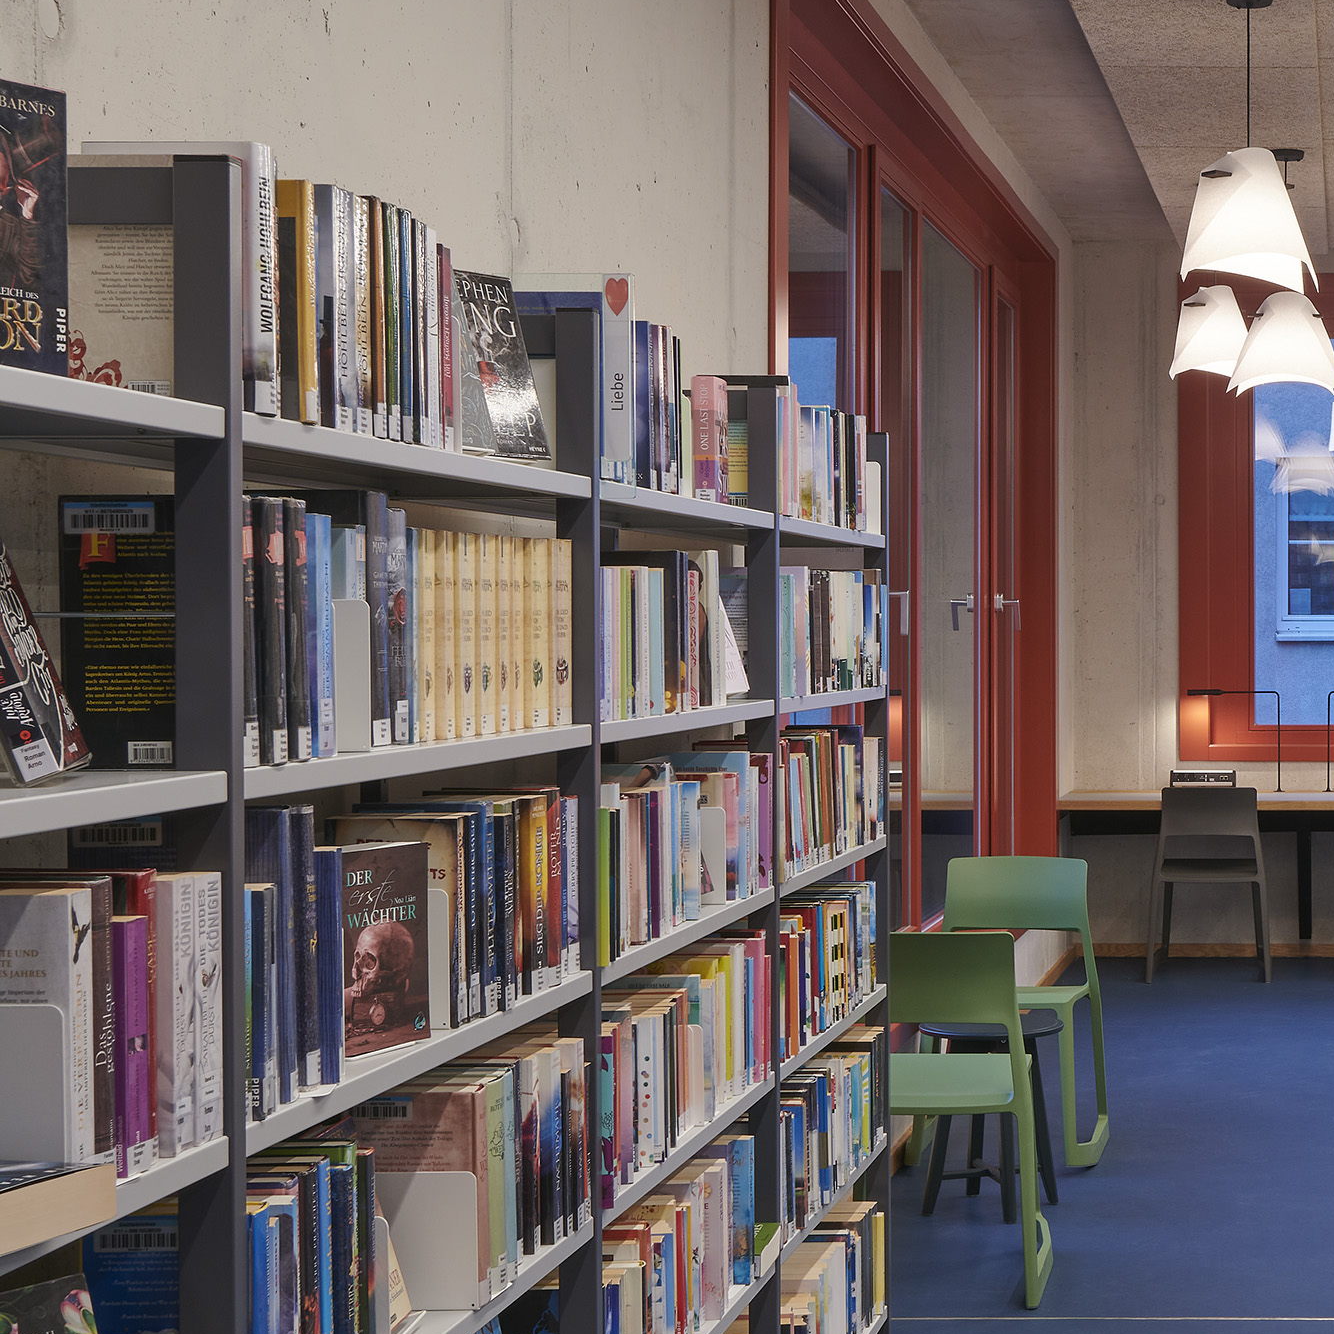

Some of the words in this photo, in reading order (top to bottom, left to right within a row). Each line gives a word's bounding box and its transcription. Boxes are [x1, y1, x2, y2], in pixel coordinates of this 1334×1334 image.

[260, 177, 272, 251] HOHLBEIN
[260, 254, 274, 334] WOLFGANG
[56, 307, 67, 353] PIPER
[611, 373, 624, 410] Liebe
[700, 386, 708, 405] STOP
[700, 409, 708, 428] LAST
[700, 430, 708, 450] ONE
[20, 744, 40, 753] Fantasy
[24, 751, 46, 762] Roman
[27, 760, 43, 769] Arno
[346, 869, 373, 888] DER
[393, 896, 404, 904] Noa
[208, 879, 219, 953] KÖNIGIN
[347, 903, 417, 929] WÄCHTER
[10, 969, 46, 979] JAHRES
[252, 1078, 260, 1108] PIPER
